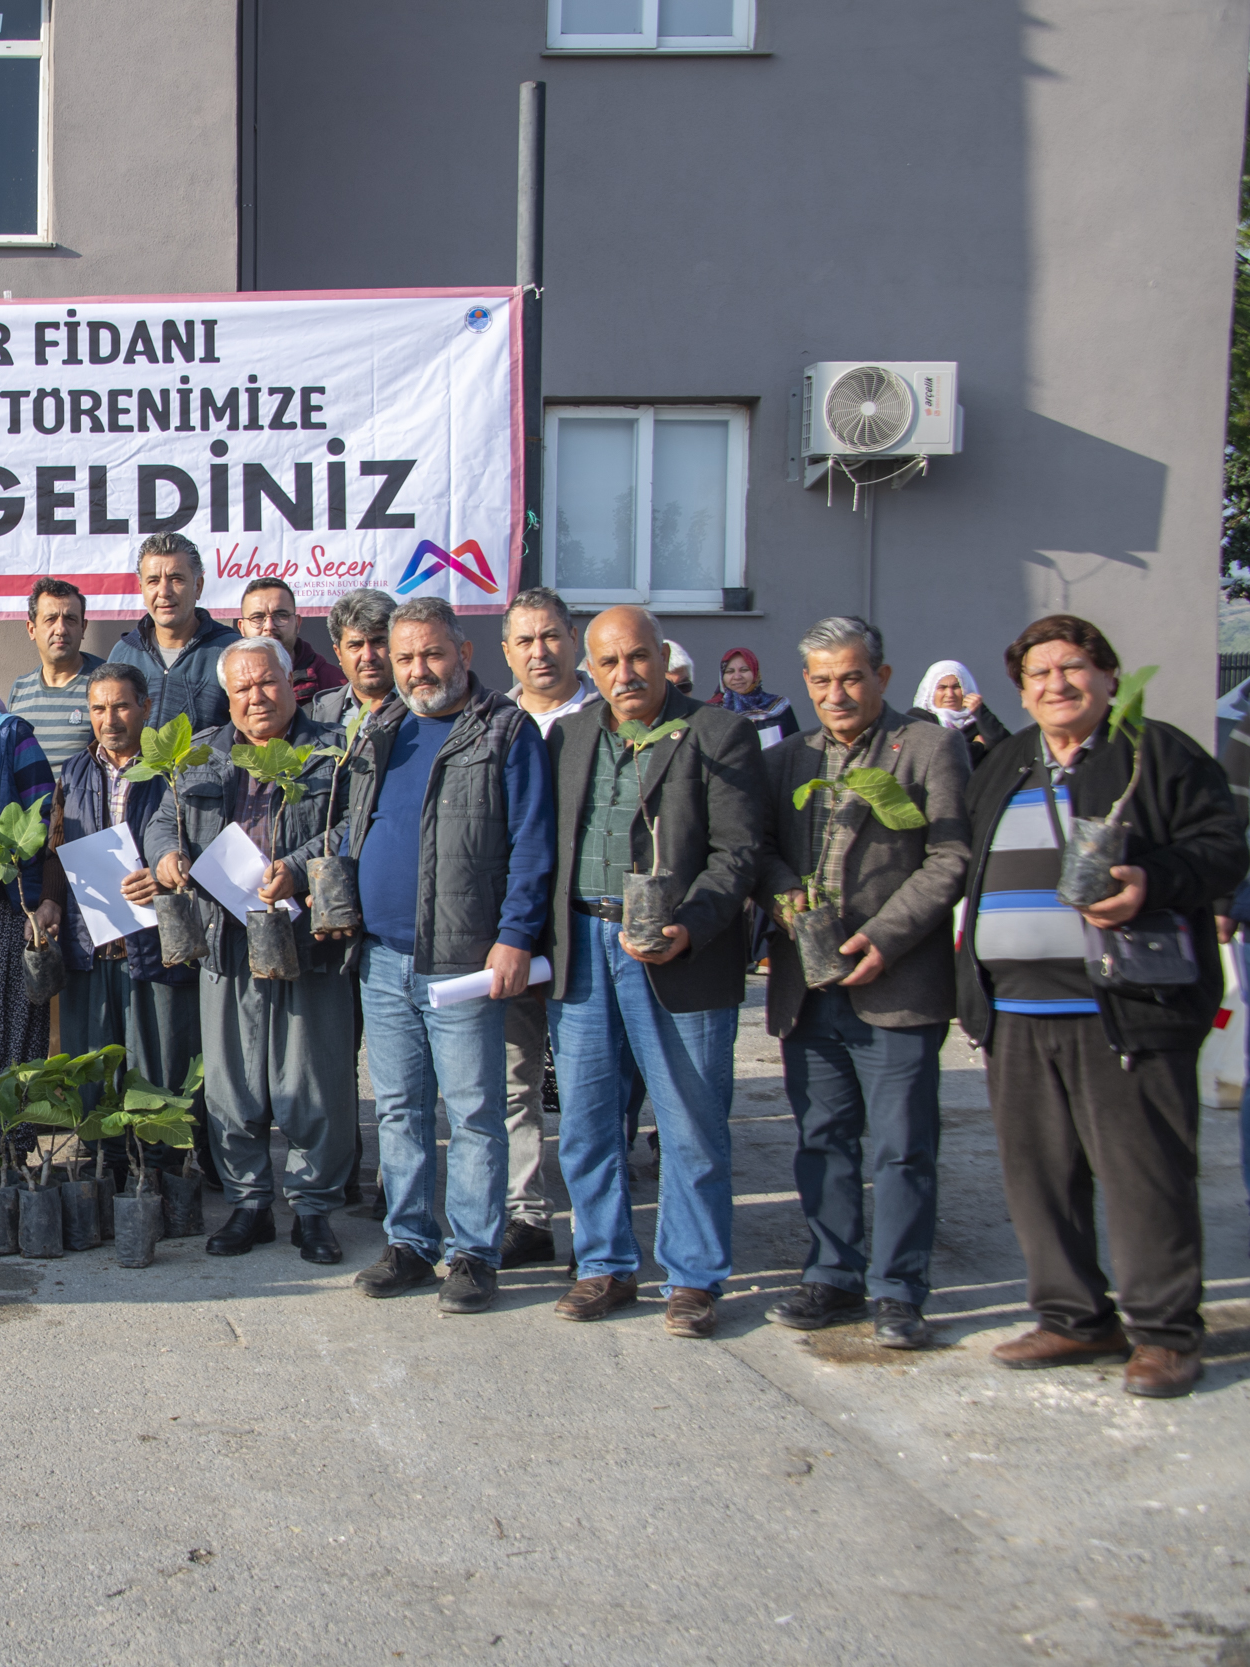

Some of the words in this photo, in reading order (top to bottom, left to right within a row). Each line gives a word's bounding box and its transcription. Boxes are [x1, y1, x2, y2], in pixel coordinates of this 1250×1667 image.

[34, 308, 221, 365] FİDANI
[0, 375, 327, 435] TÖRENİMİZE
[216, 543, 299, 580] Vahap
[306, 545, 374, 579] Seçer
[293, 589, 325, 597] ELEDİYE
[303, 580, 335, 588] MERSİN
